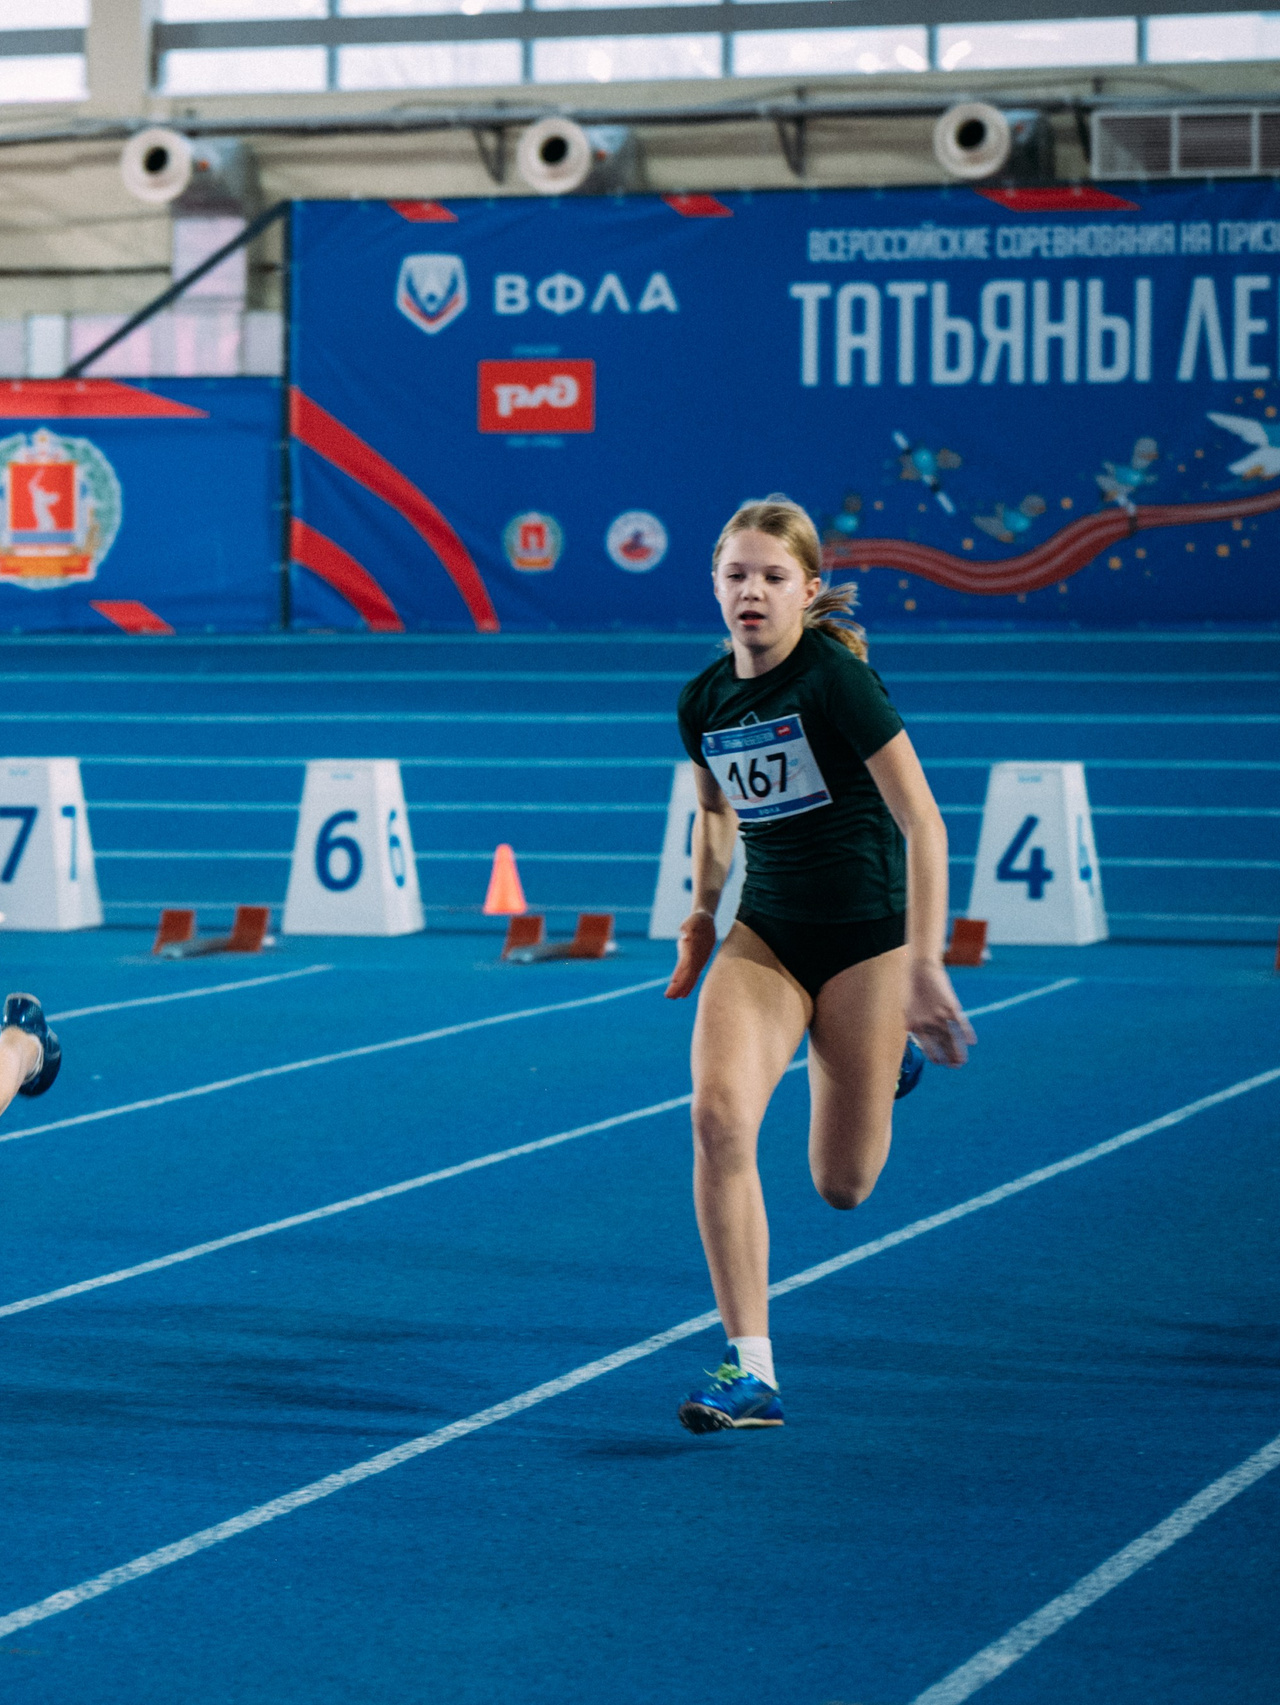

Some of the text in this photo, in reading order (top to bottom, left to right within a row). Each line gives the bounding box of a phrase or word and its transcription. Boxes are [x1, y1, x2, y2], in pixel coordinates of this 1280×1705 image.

[808, 220, 1280, 261] ВСЕРОССИЙСКИЕ СОРЕВНОВАНИЯ НА ПРИЗ
[494, 271, 679, 315] ВФЛА
[789, 275, 1280, 386] ТАТЬЯНЫ ЛЕ
[728, 751, 788, 800] 167
[315, 810, 362, 892] 6
[996, 814, 1053, 900] 4
